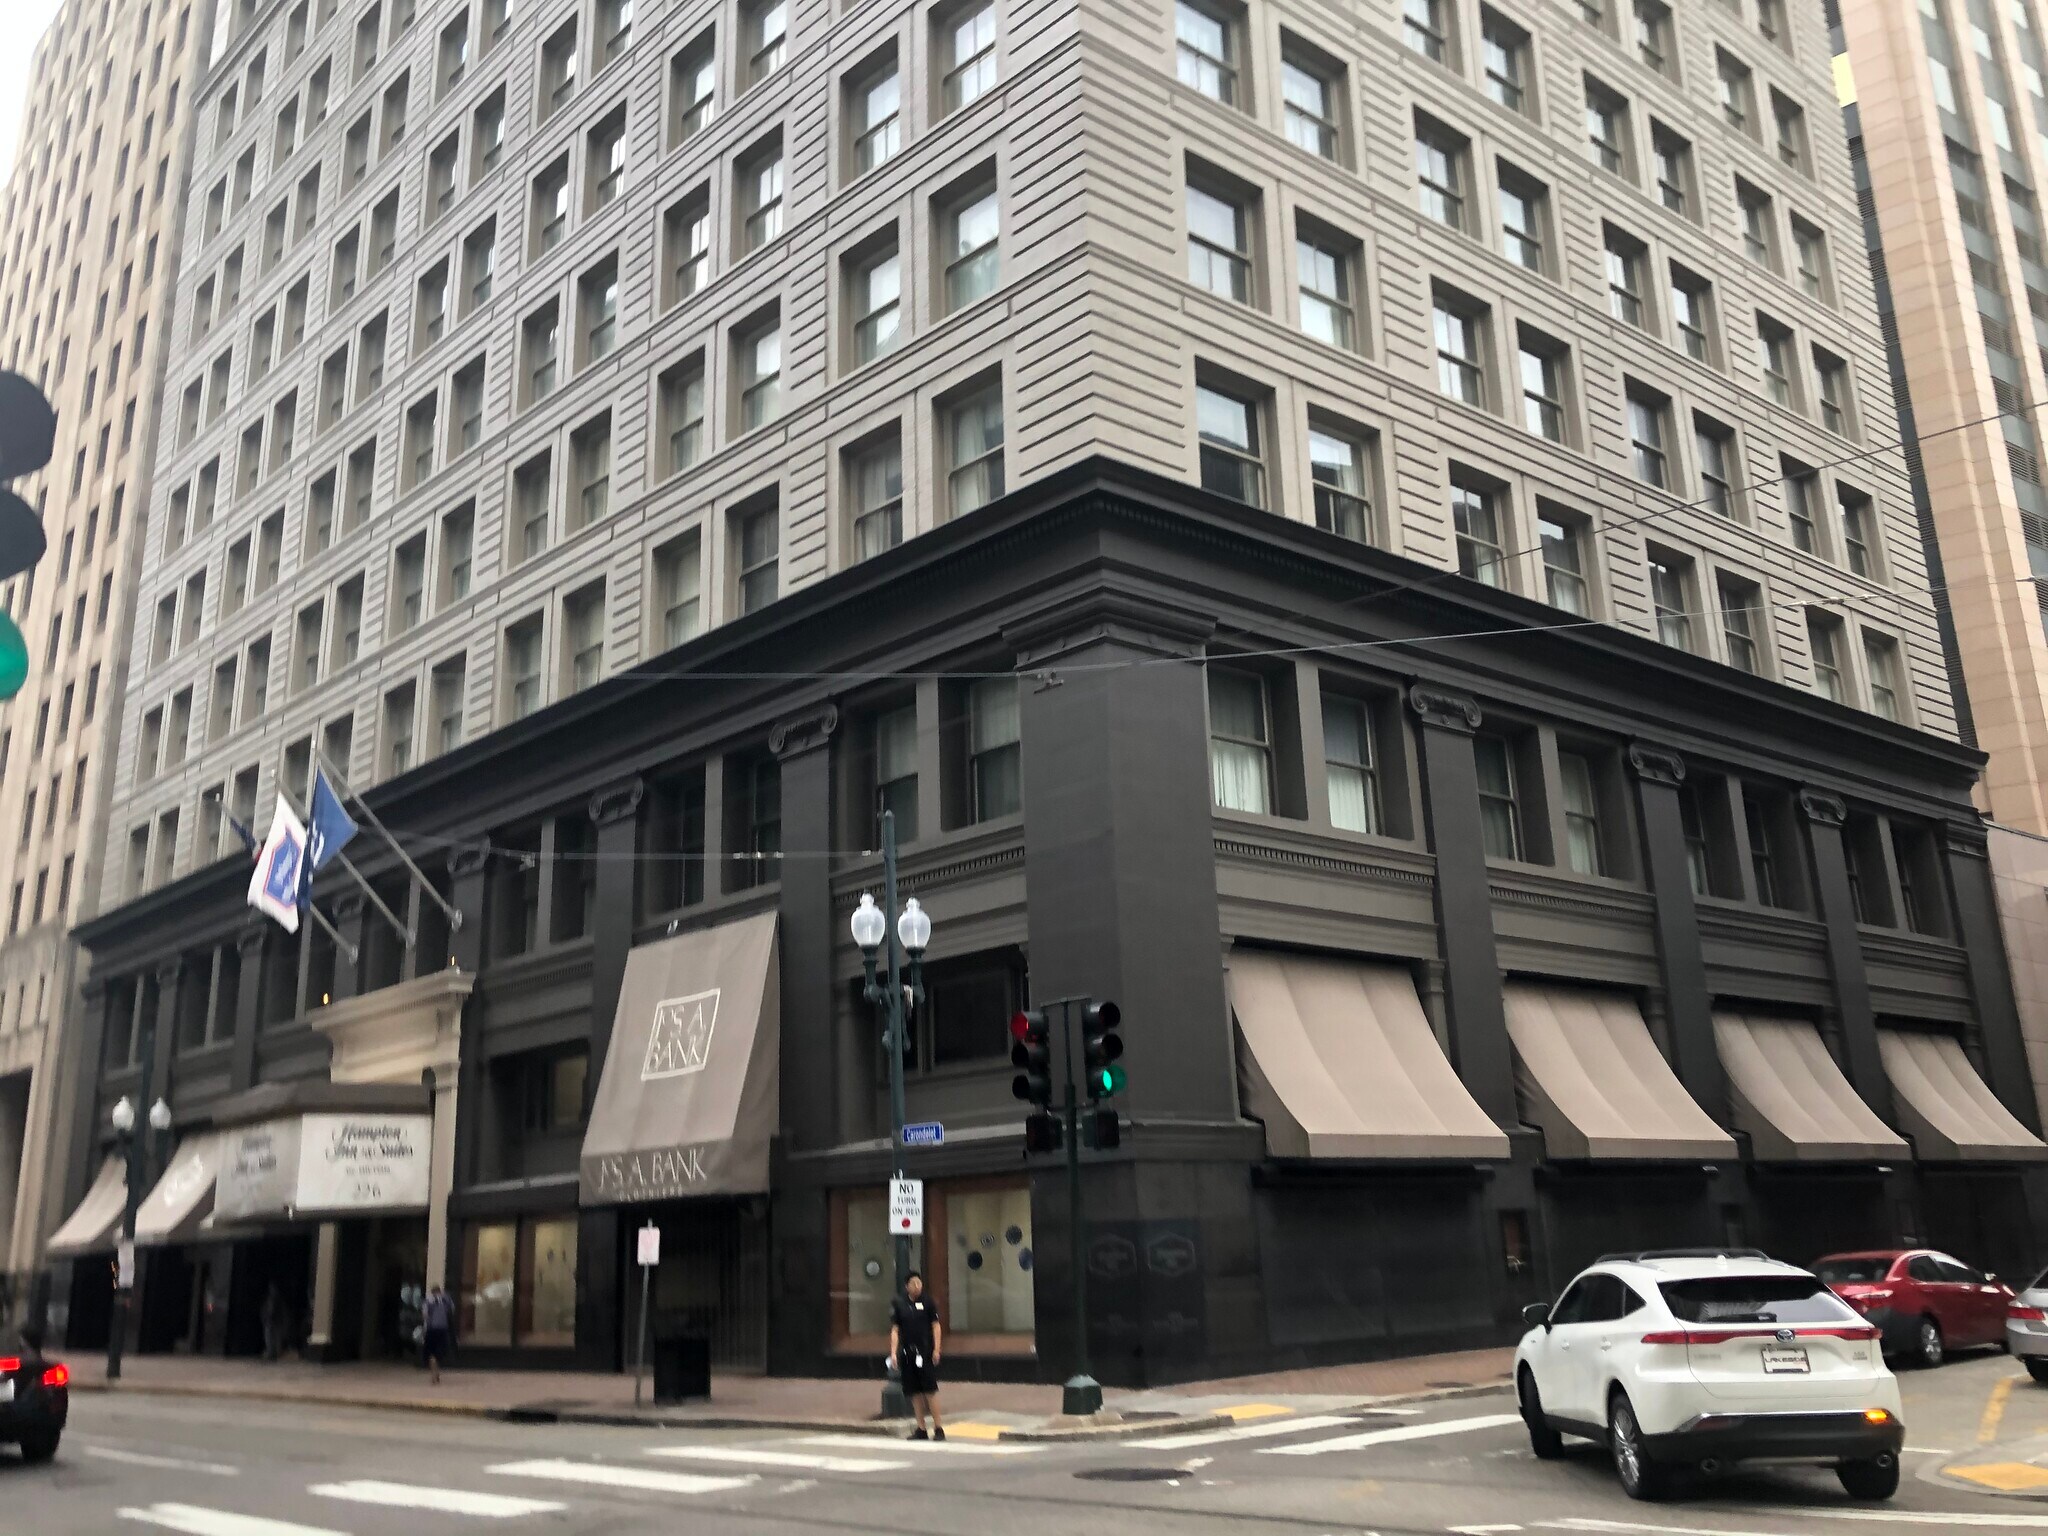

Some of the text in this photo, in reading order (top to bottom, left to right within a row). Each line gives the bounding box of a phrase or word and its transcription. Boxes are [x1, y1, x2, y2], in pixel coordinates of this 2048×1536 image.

[646, 1034, 705, 1072] BANK
[652, 1146, 707, 1184] BANK
[899, 1183, 914, 1195] NO
[897, 1196, 917, 1206] TURN
[892, 1206, 921, 1217] ON RED
